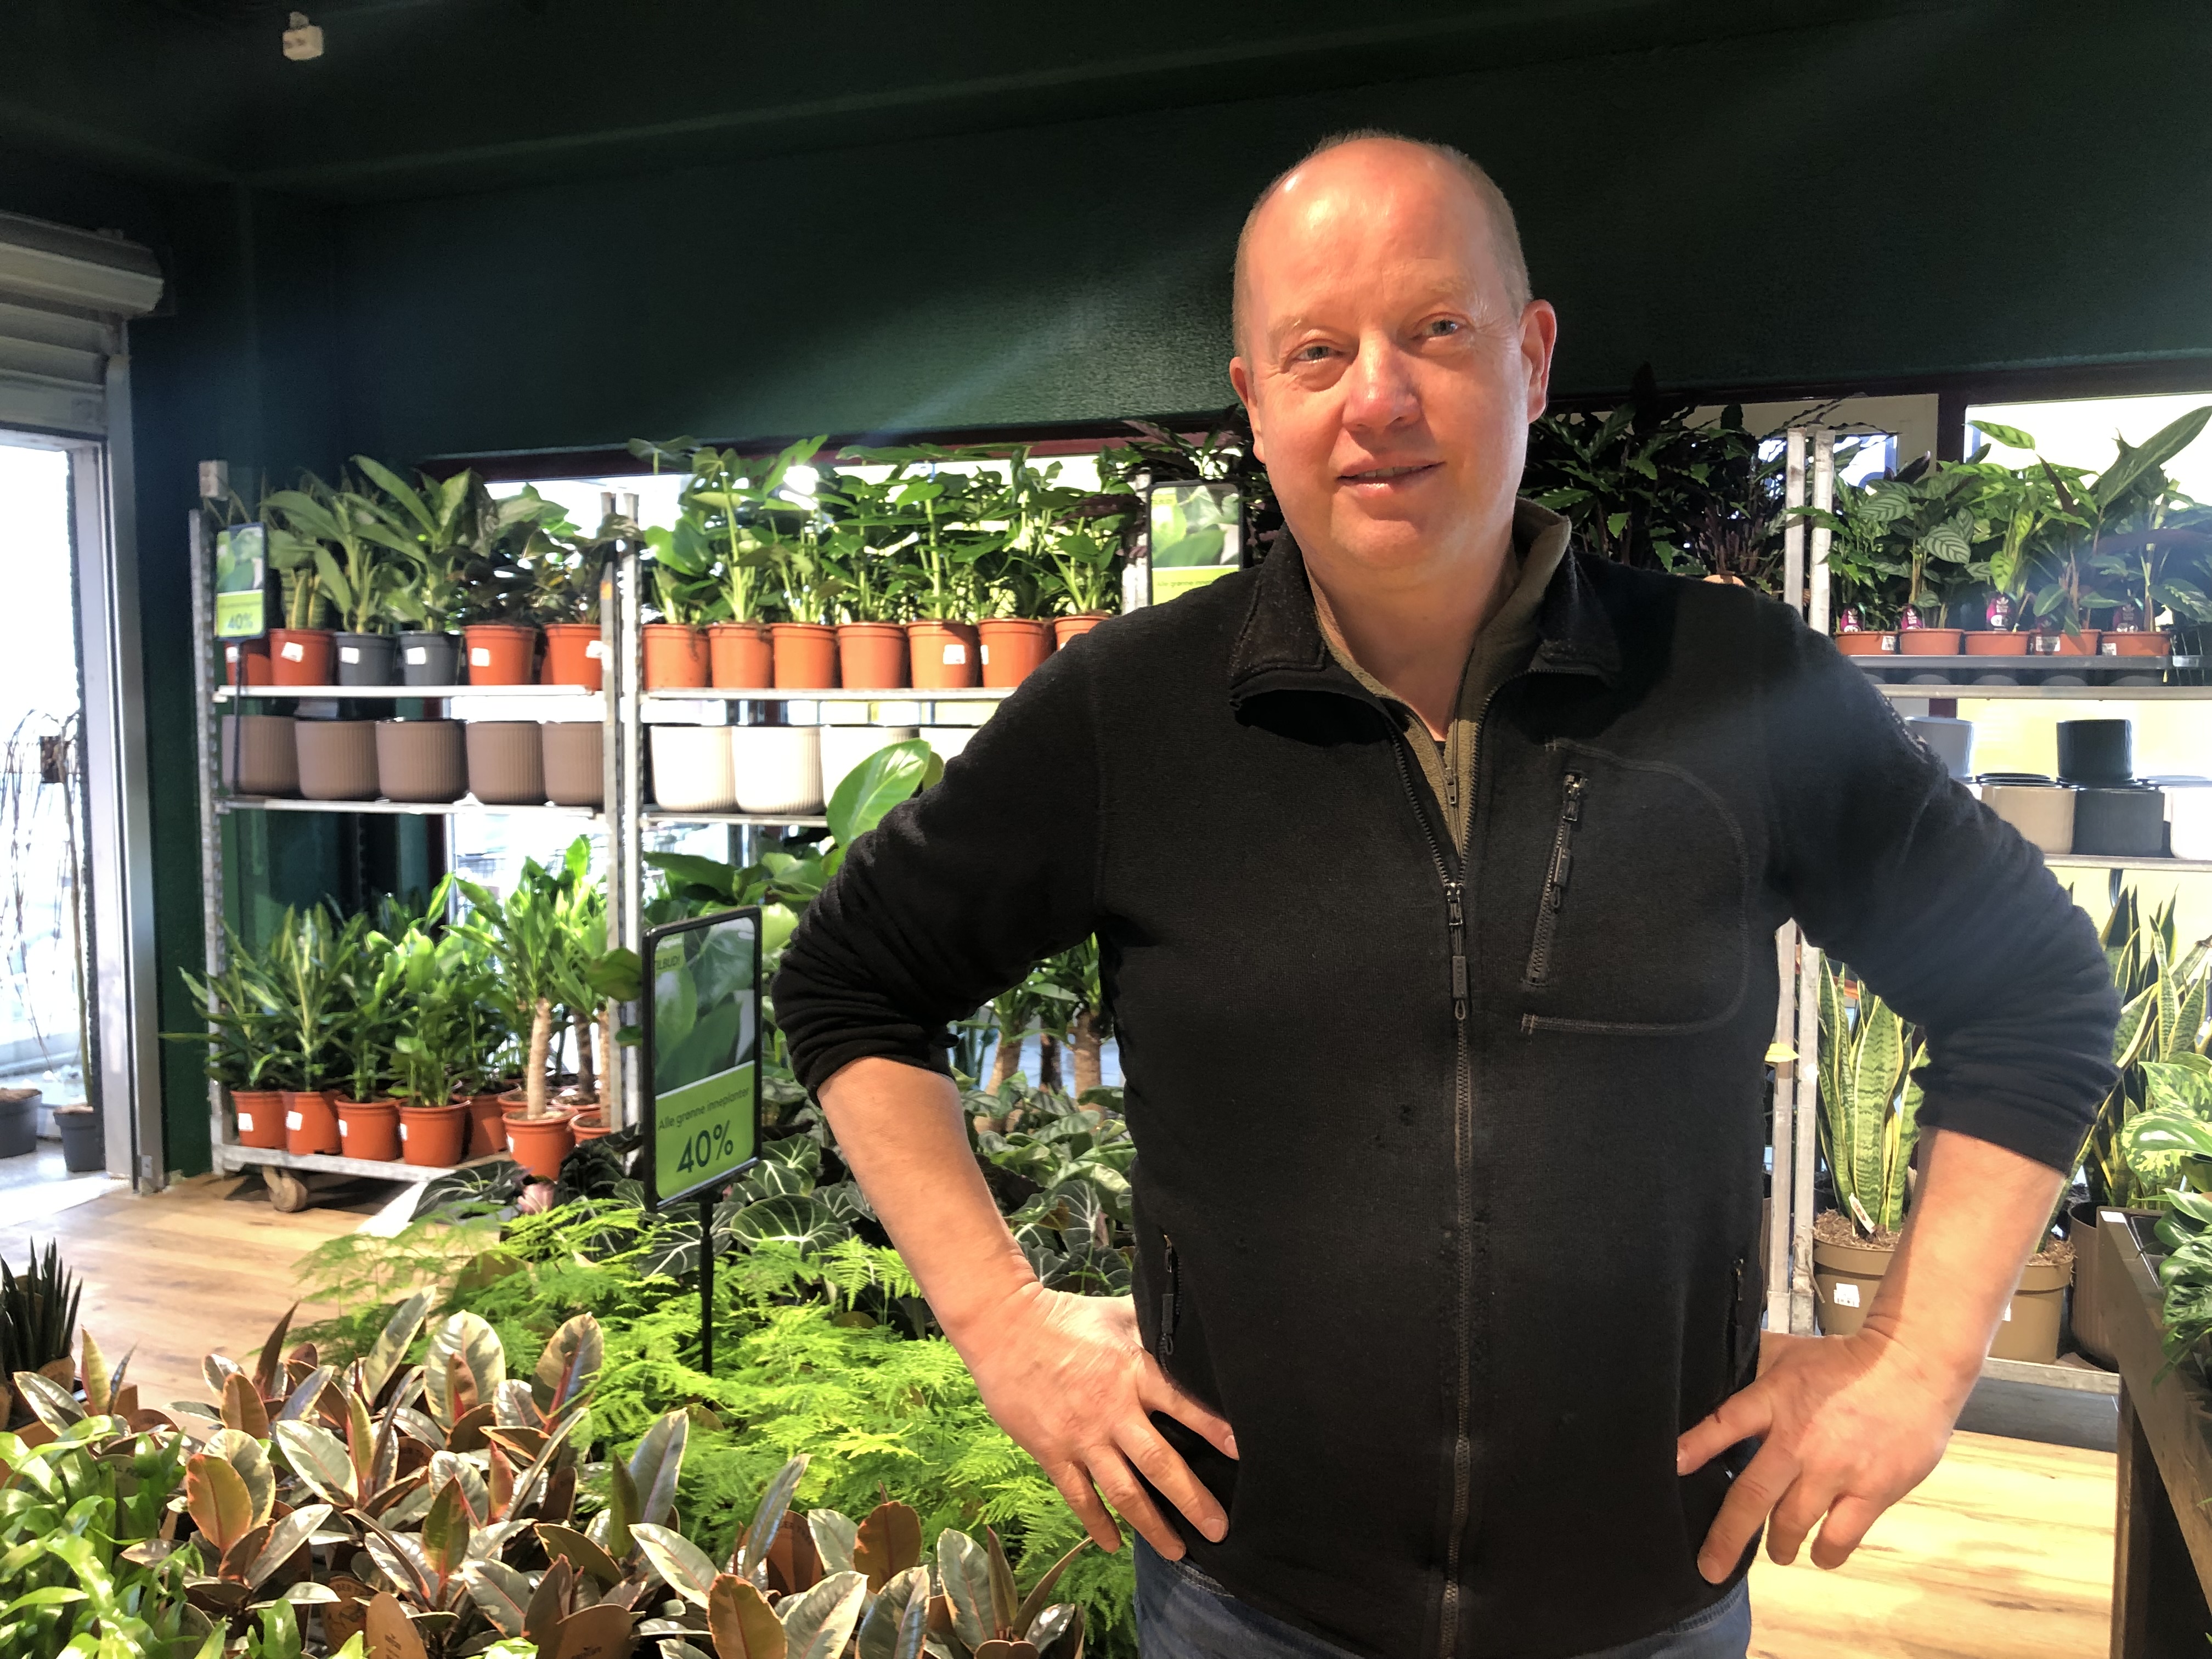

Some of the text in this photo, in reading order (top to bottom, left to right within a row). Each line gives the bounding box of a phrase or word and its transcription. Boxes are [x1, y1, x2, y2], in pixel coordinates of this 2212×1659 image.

[227, 612, 253, 630] 40%
[658, 1087, 749, 1130] Alle grønne inneplanter
[676, 1119, 733, 1173] 40%
